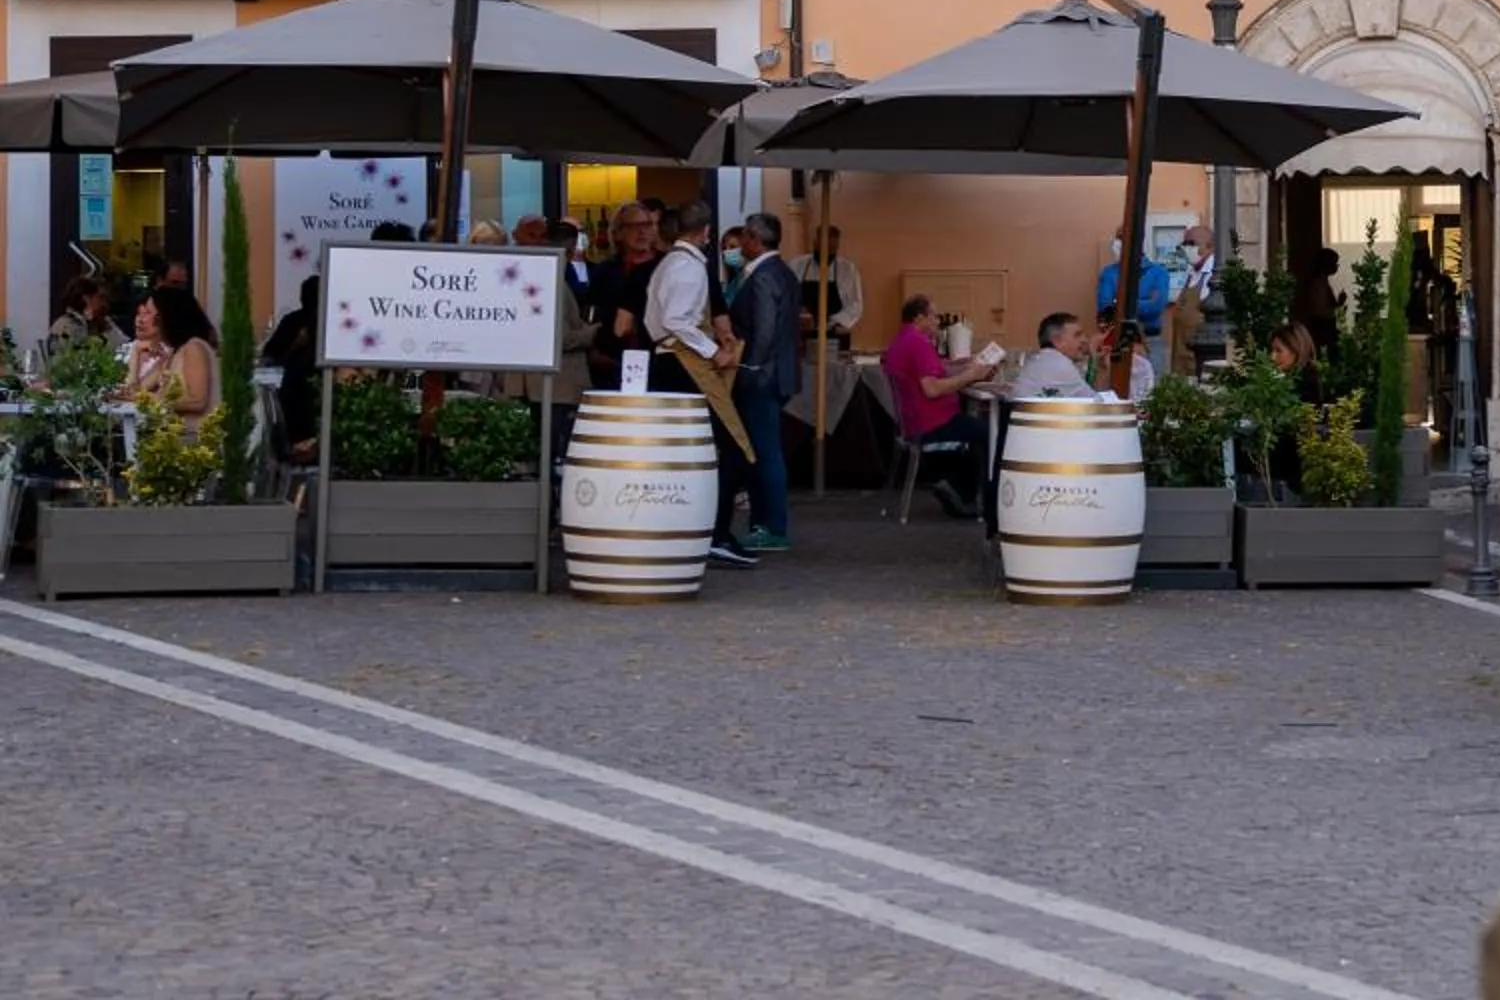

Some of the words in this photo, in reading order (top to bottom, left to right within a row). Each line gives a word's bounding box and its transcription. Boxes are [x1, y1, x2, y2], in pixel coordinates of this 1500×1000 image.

[301, 215, 338, 230] WINE
[343, 215, 400, 230] GAR
[411, 264, 479, 292] SORÉ
[369, 296, 428, 319] WINE
[433, 299, 518, 322] GARDEN
